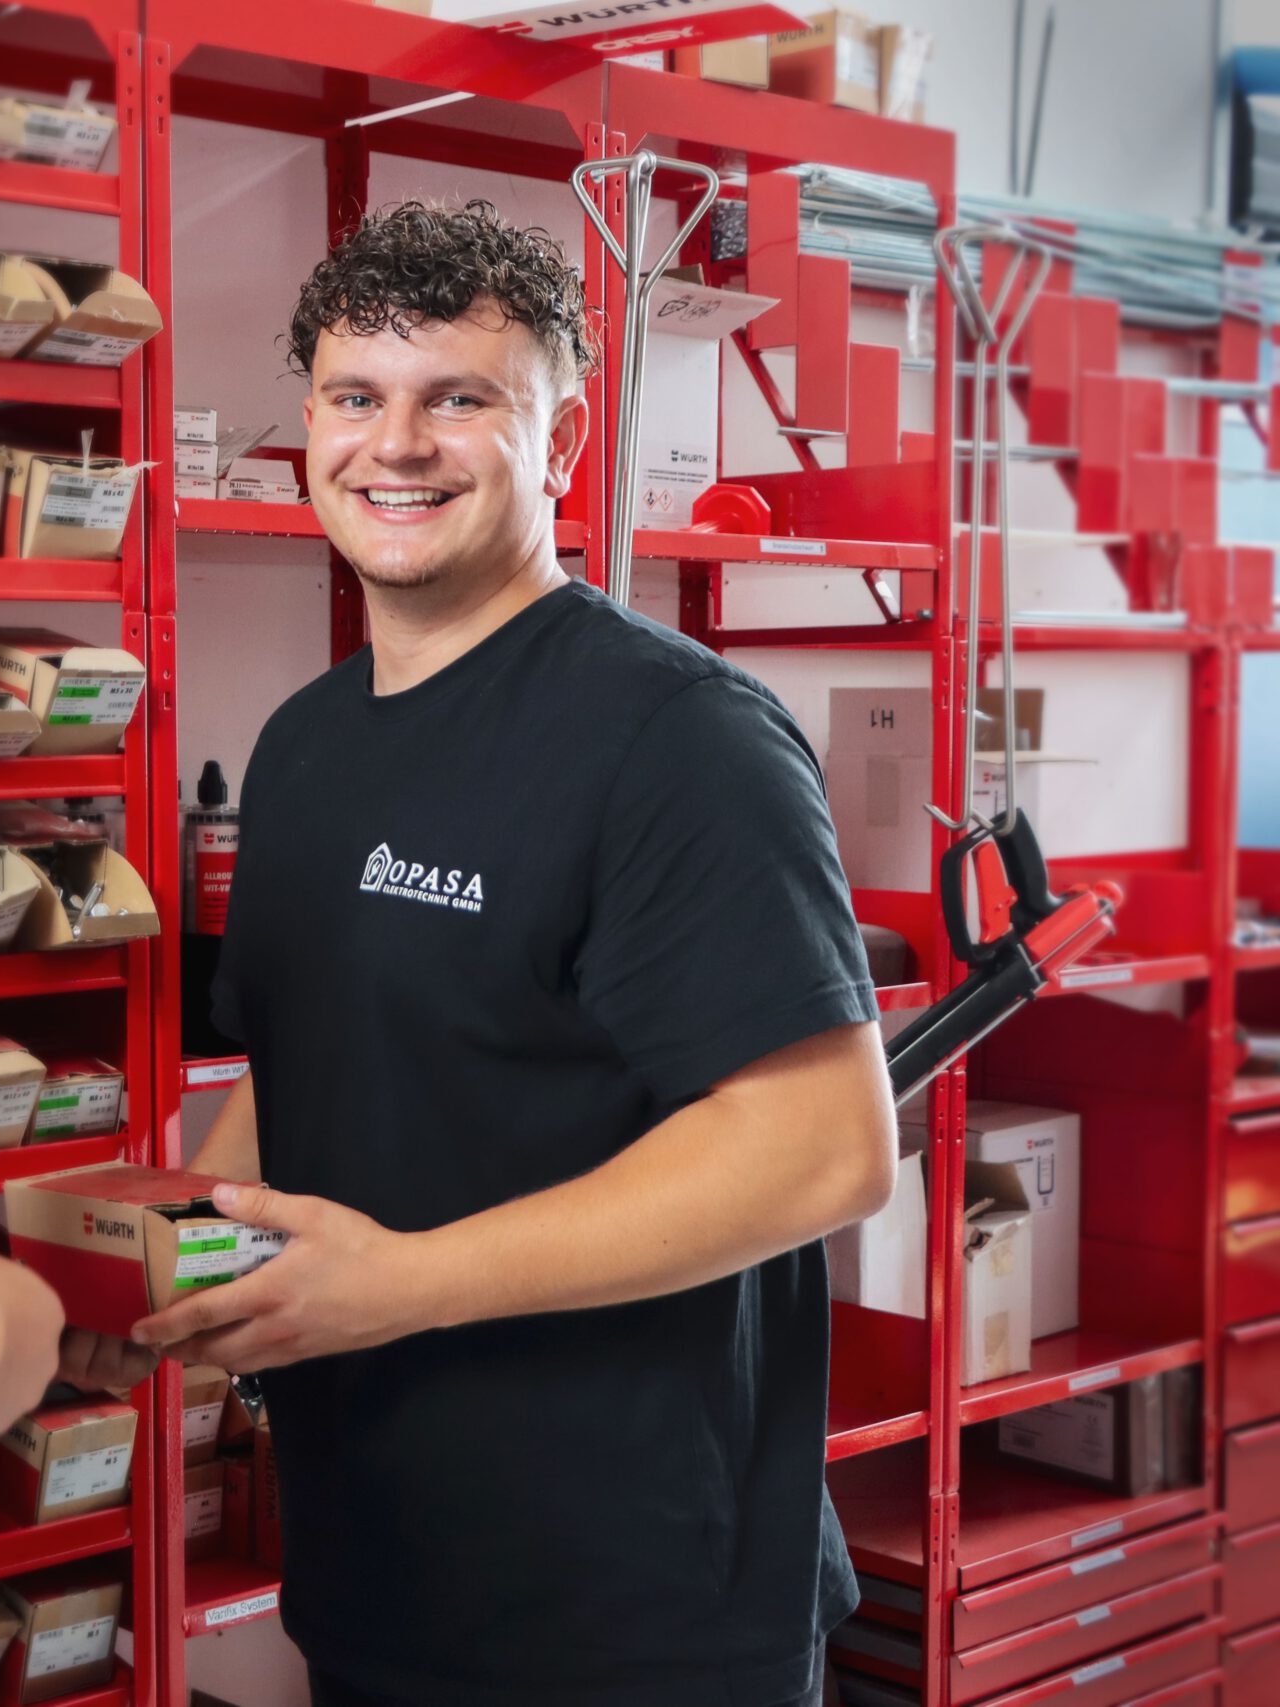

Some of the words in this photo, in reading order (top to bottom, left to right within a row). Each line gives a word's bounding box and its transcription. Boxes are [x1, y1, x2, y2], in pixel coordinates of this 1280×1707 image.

[388, 860, 484, 899] OPASA
[382, 884, 449, 906] ELEKTROTECHNIK
[452, 897, 482, 913] GMBH
[95, 1218, 135, 1240] WÜRTH
[251, 1234, 264, 1243] M8
[272, 1231, 283, 1241] 70
[240, 1596, 276, 1614] System
